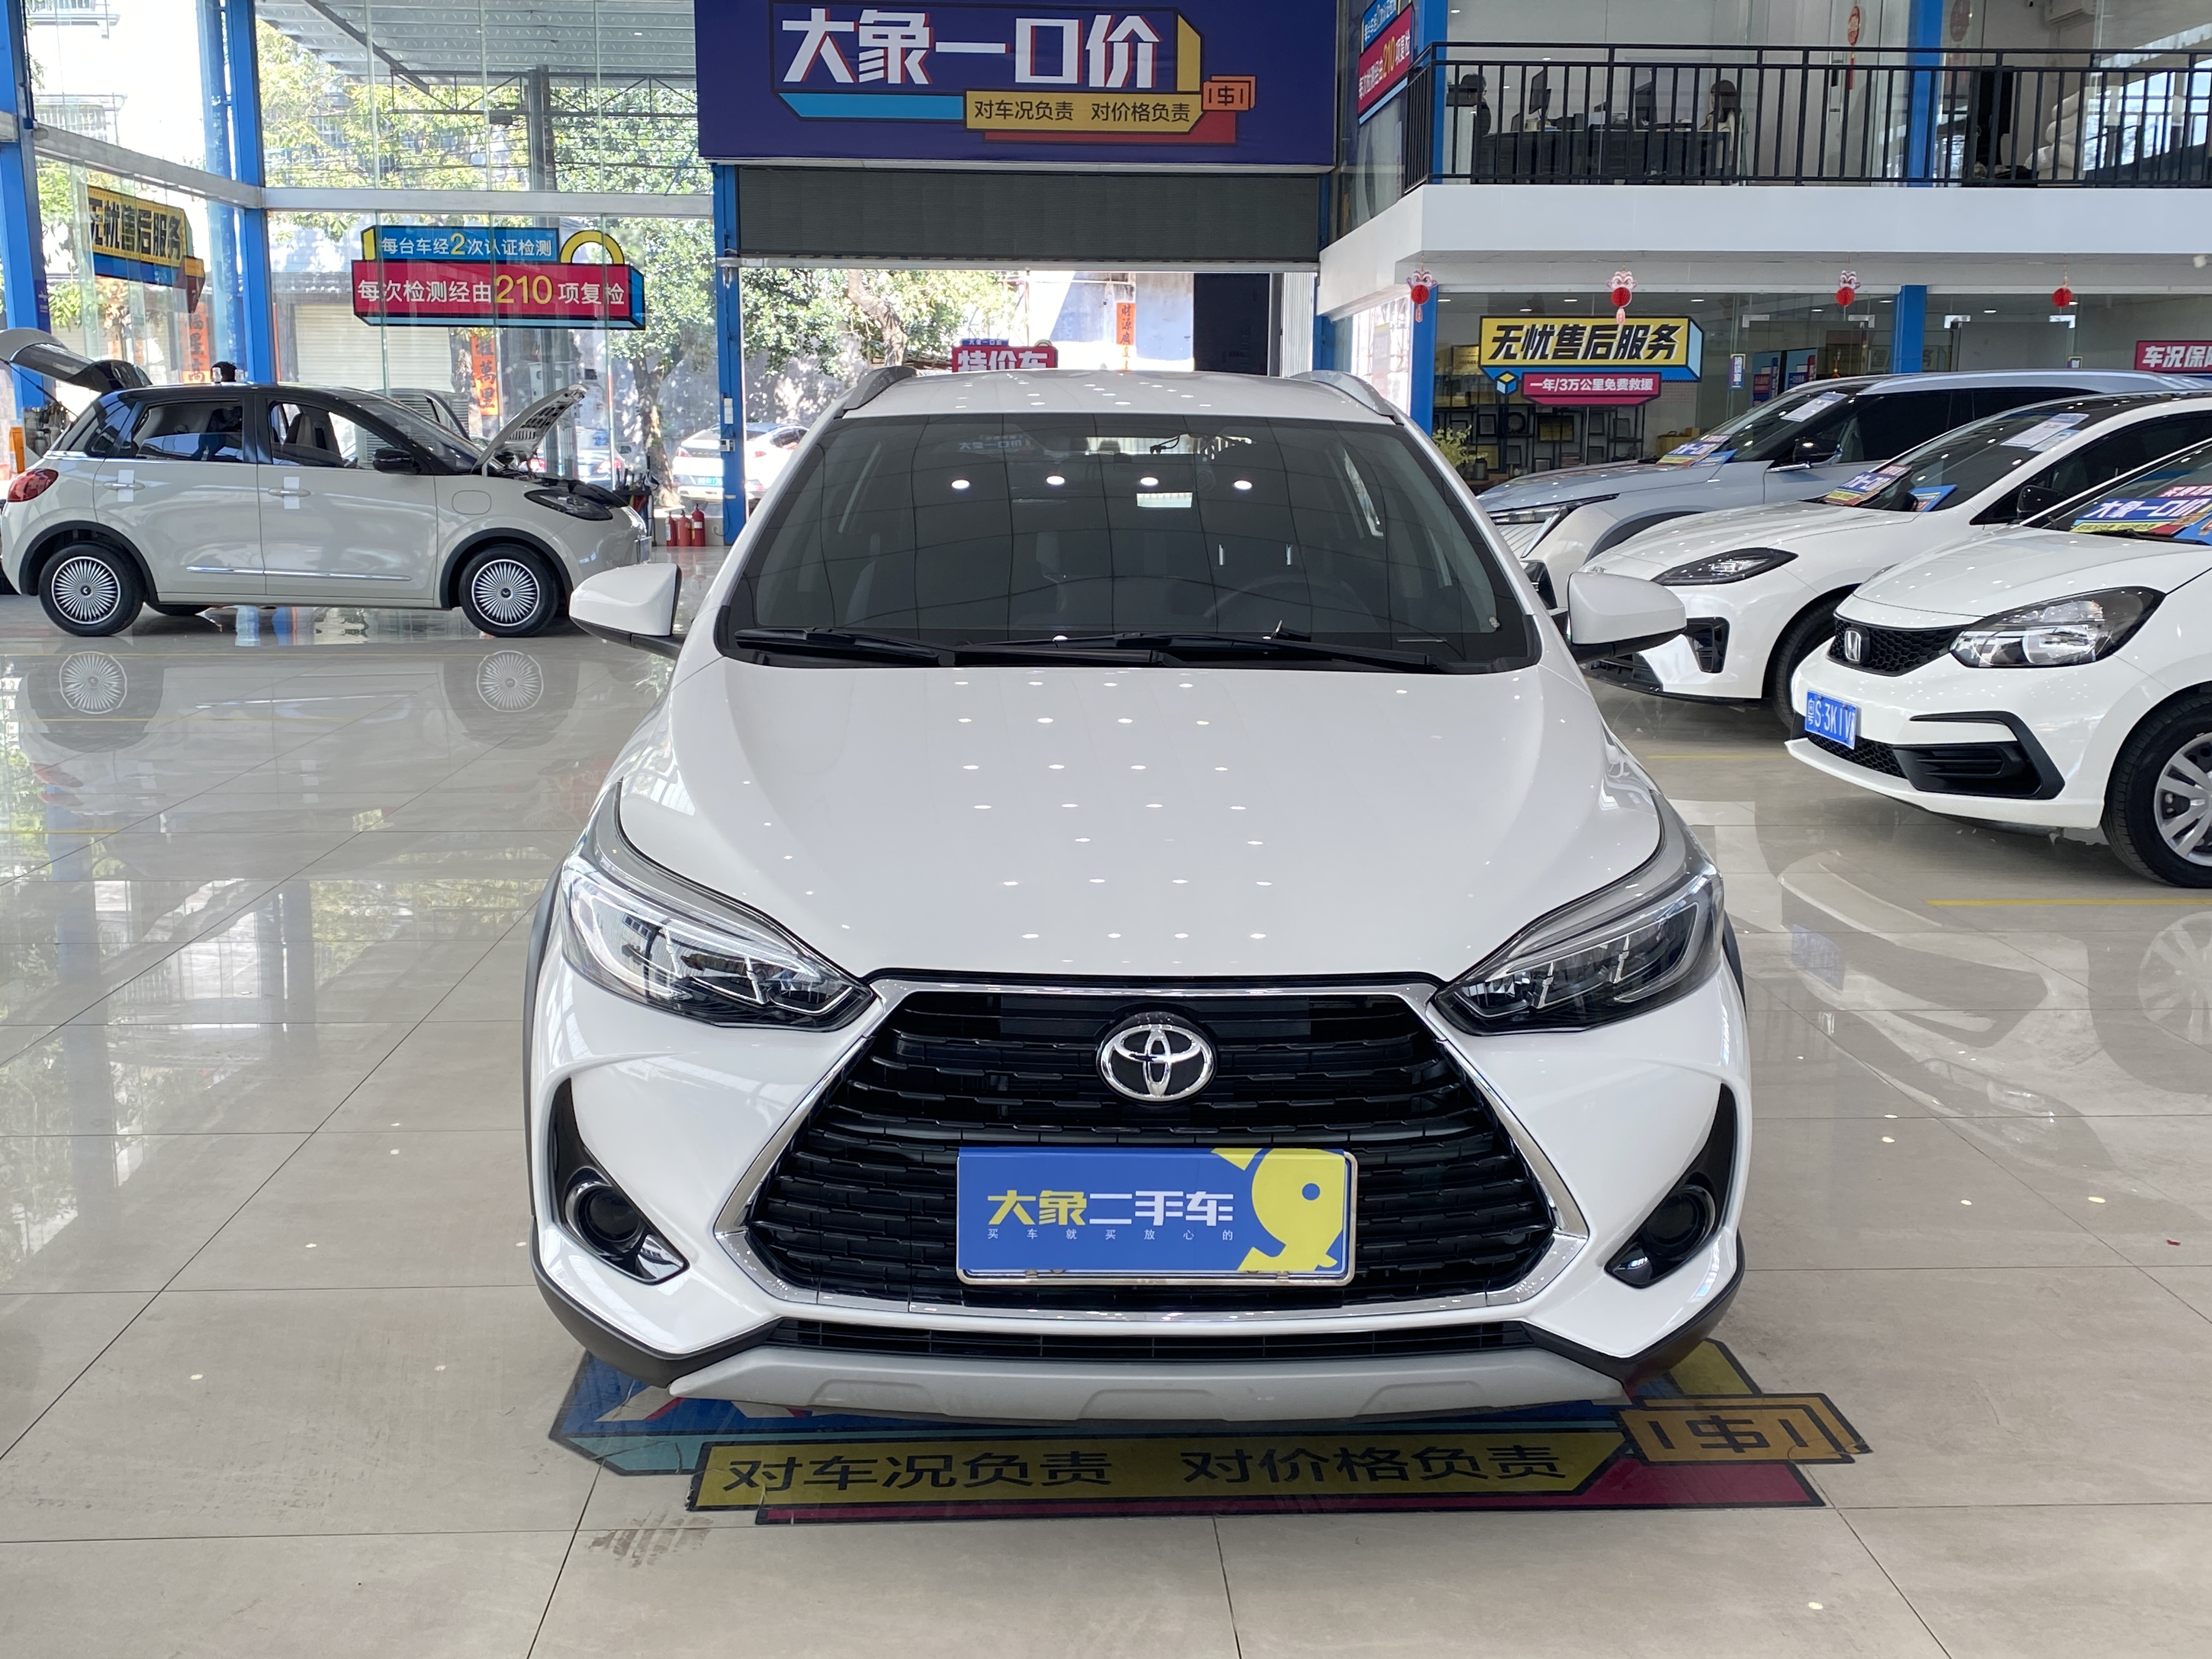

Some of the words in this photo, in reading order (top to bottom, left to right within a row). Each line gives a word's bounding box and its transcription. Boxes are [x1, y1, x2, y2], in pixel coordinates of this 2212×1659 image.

[782, 8, 1162, 88] 大象一口价
[974, 99, 1074, 122] 对车况负责
[1091, 102, 1190, 123] 对价格负责
[382, 233, 552, 257] 每台车经2次认证检测
[1488, 324, 1684, 359] 无忧售后服务
[957, 351, 1047, 371] 特价车
[1530, 379, 1654, 392] 一年/3万公里免费救援
[2083, 498, 2211, 518] 大象一口价
[987, 1190, 1234, 1227] 大象二手车
[988, 1228, 1233, 1241] 买车就买放心的
[723, 1451, 1112, 1491] 对车况负责
[1180, 1444, 1565, 1485] 对价格负责
